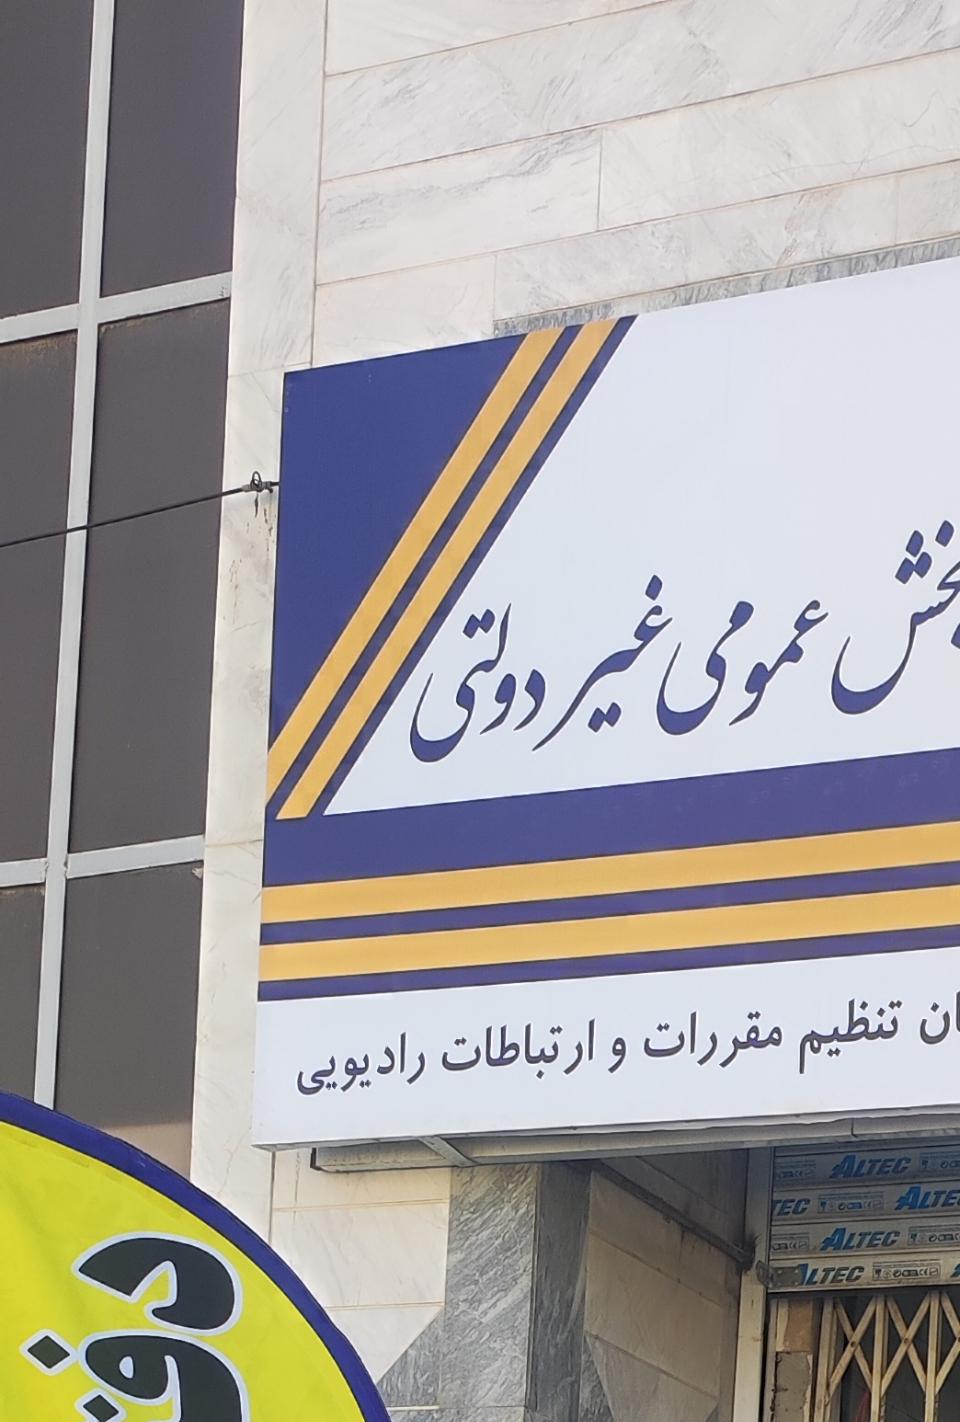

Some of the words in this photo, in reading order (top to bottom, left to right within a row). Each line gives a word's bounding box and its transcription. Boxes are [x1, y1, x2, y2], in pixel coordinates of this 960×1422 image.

[410, 603, 547, 763] دولتی
[534, 575, 673, 751] غیر
[656, 601, 828, 735] عمومی
[442, 1018, 593, 1084] ارتباطات
[610, 1036, 628, 1073] و
[643, 1011, 783, 1066] مقررات
[799, 994, 900, 1073] تنظیم
[296, 1041, 425, 1097] رادیویی
[829, 1154, 911, 1179] ALTEC
[772, 1198, 810, 1217] TEC
[820, 1227, 900, 1251] ALTEC
